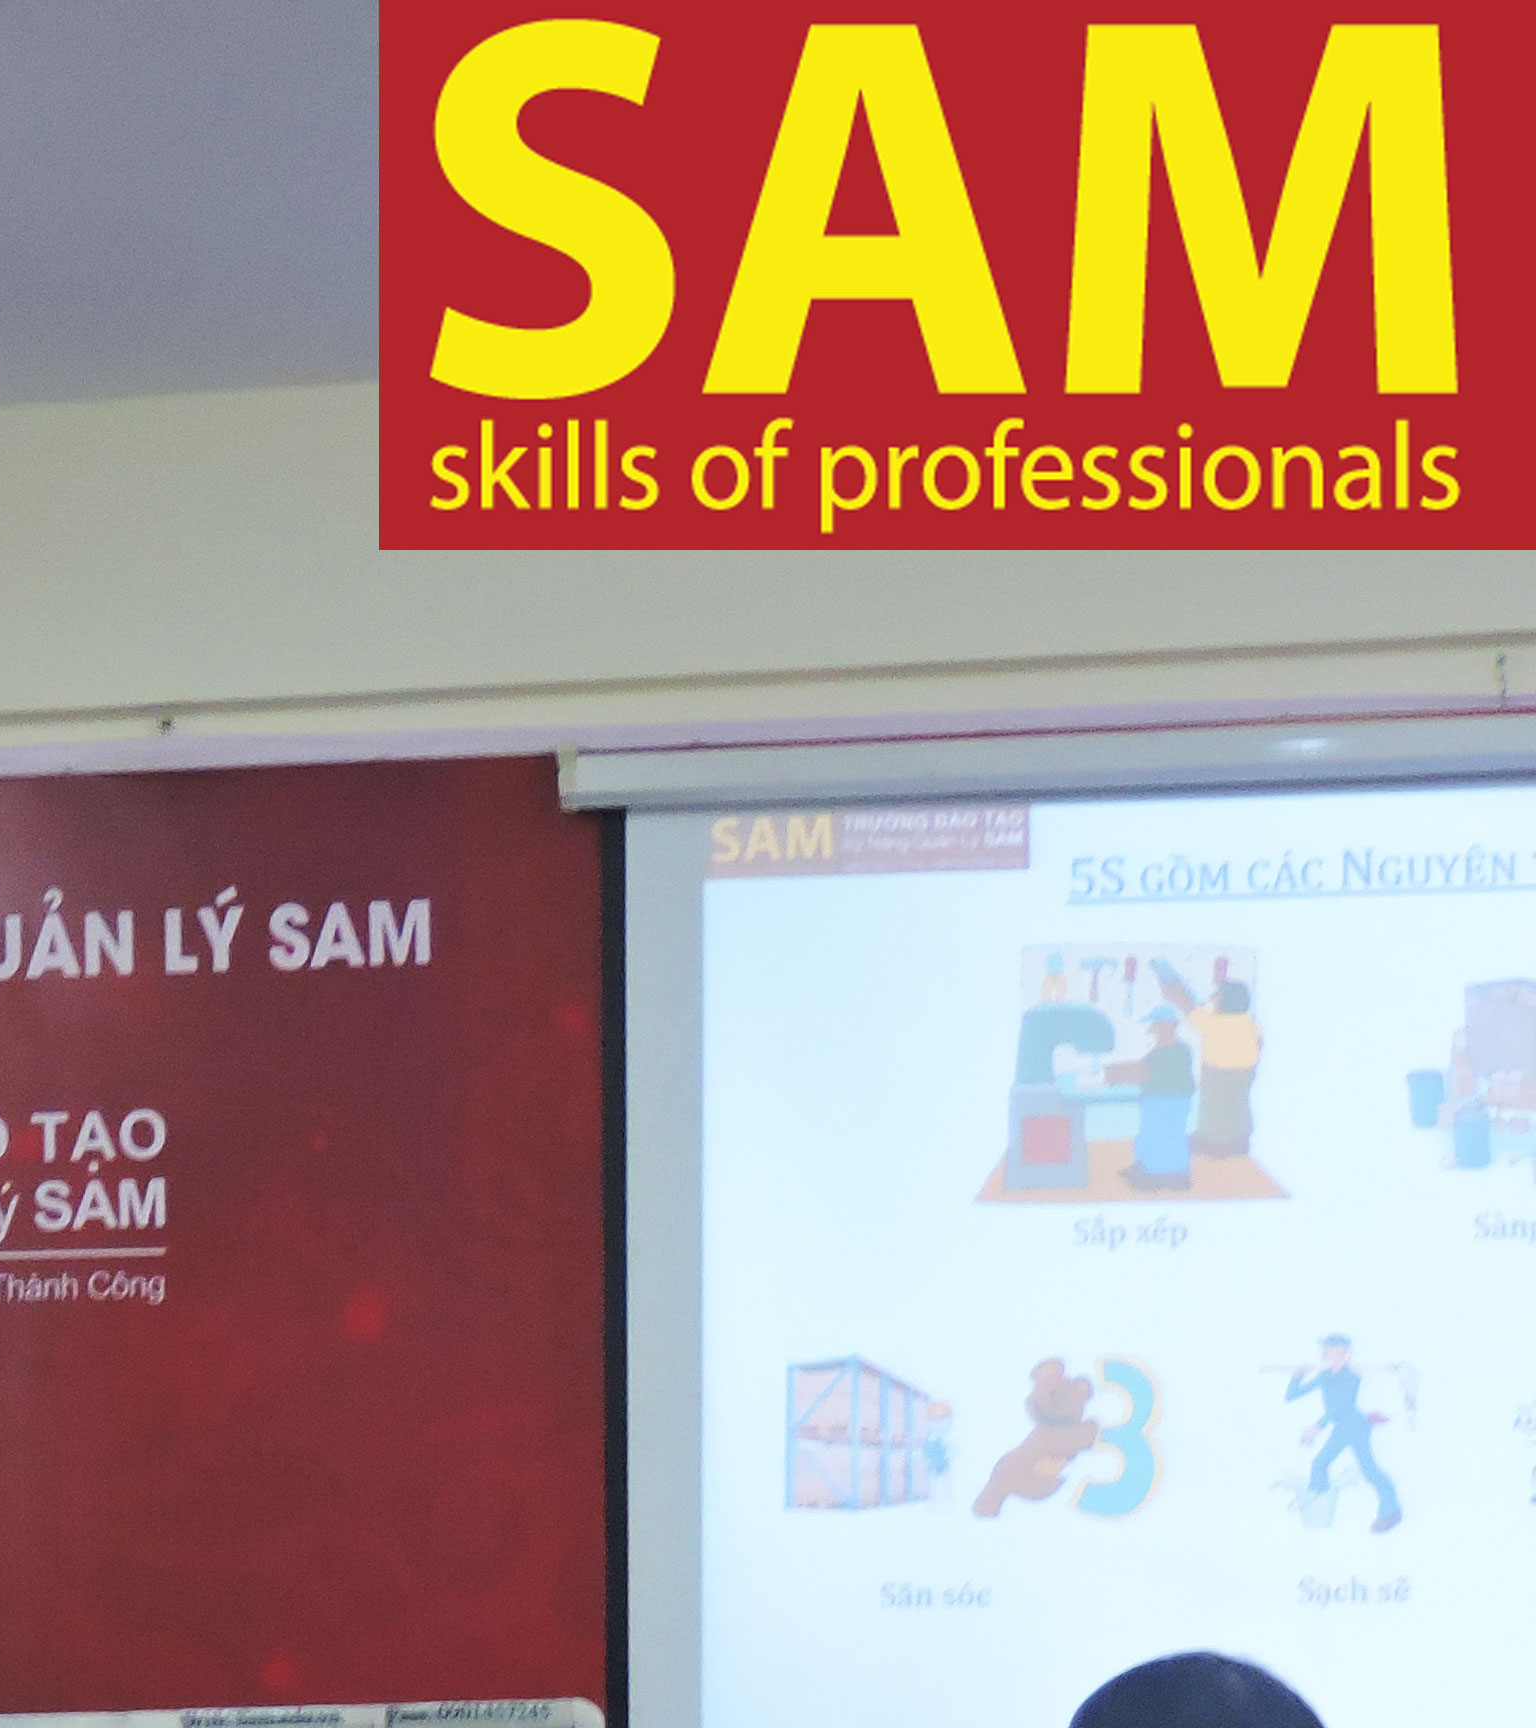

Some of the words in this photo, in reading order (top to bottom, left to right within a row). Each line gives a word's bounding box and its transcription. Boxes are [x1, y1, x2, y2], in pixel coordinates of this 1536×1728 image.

[710, 813, 835, 863] SAM
[1070, 855, 1126, 897] 5S
[1247, 848, 1324, 893] CÁC
[1341, 843, 1517, 890] NGUYÊN
[163, 885, 245, 976] LÝ
[268, 898, 431, 972] SAM
[30, 1107, 166, 1174] TẠO
[33, 1176, 167, 1233] SAM
[87, 1269, 166, 1307] Công
